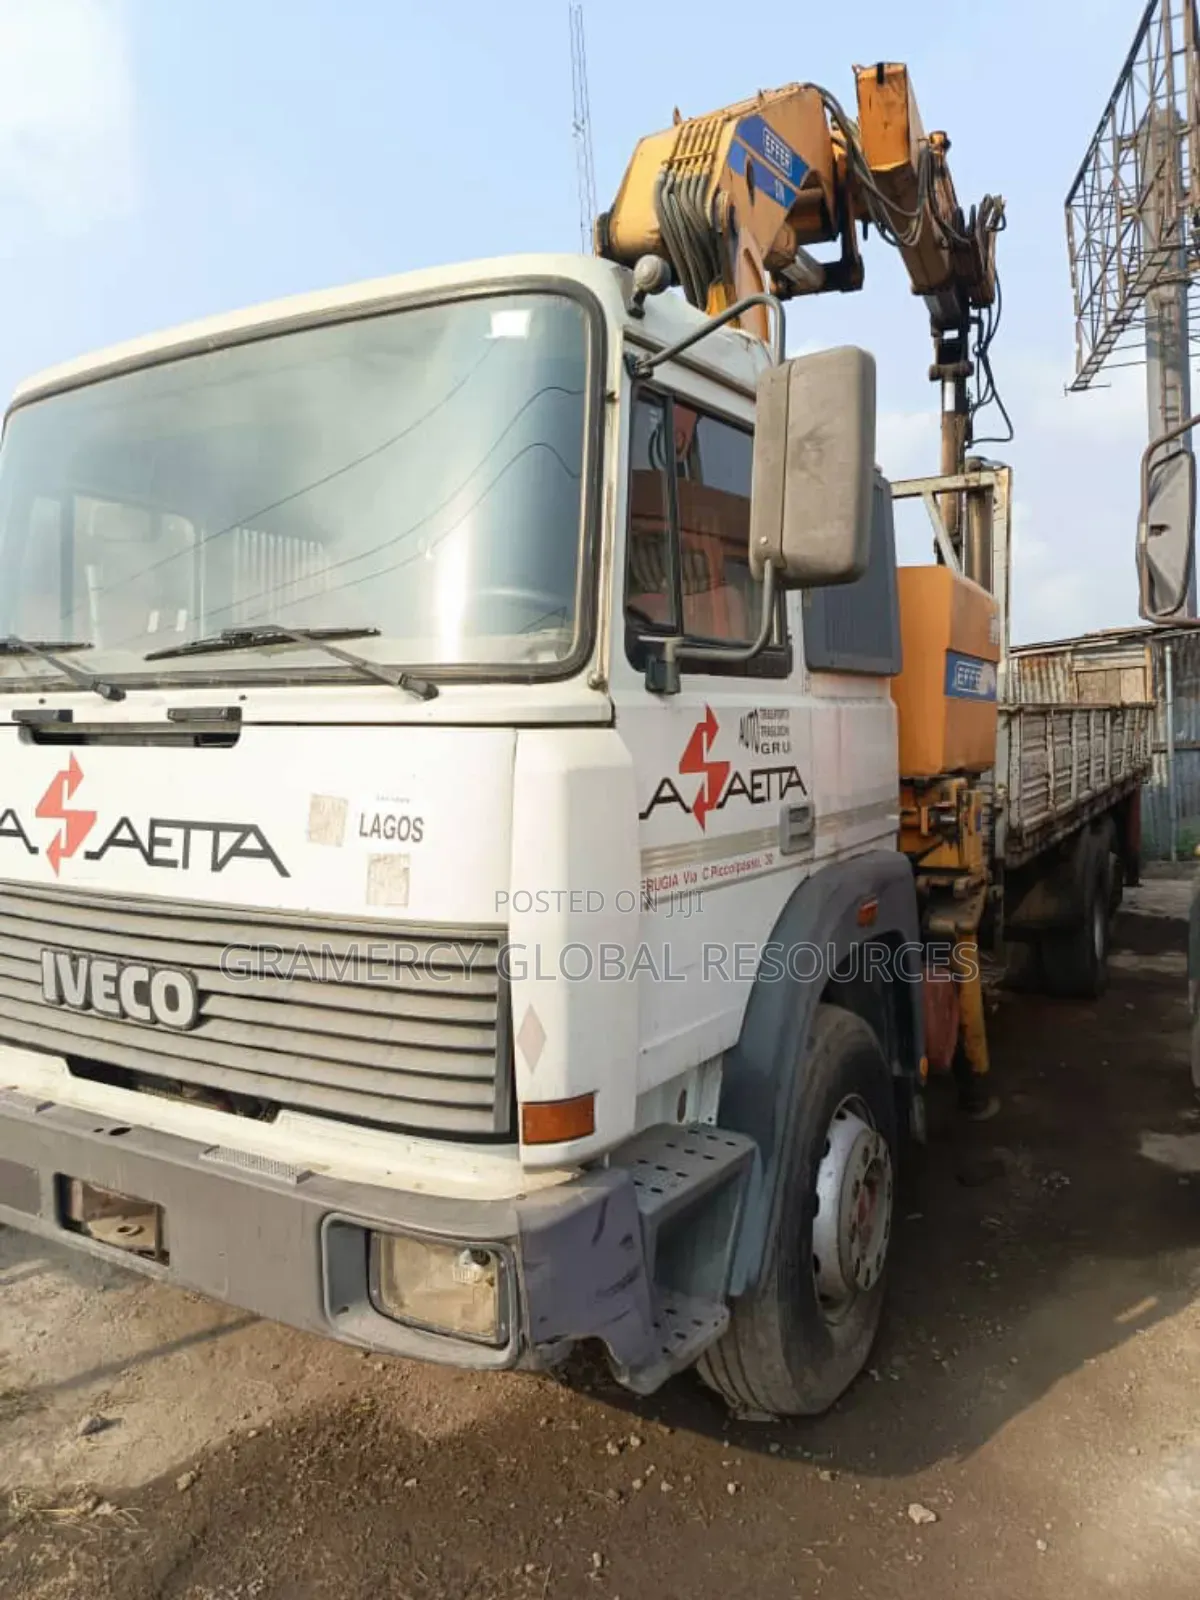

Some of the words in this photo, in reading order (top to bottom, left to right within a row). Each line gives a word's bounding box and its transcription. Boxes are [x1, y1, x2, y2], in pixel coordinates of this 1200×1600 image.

[760, 741, 792, 755] GRU
[358, 812, 425, 843] LAGOS
[40, 947, 200, 1032] IVECO
